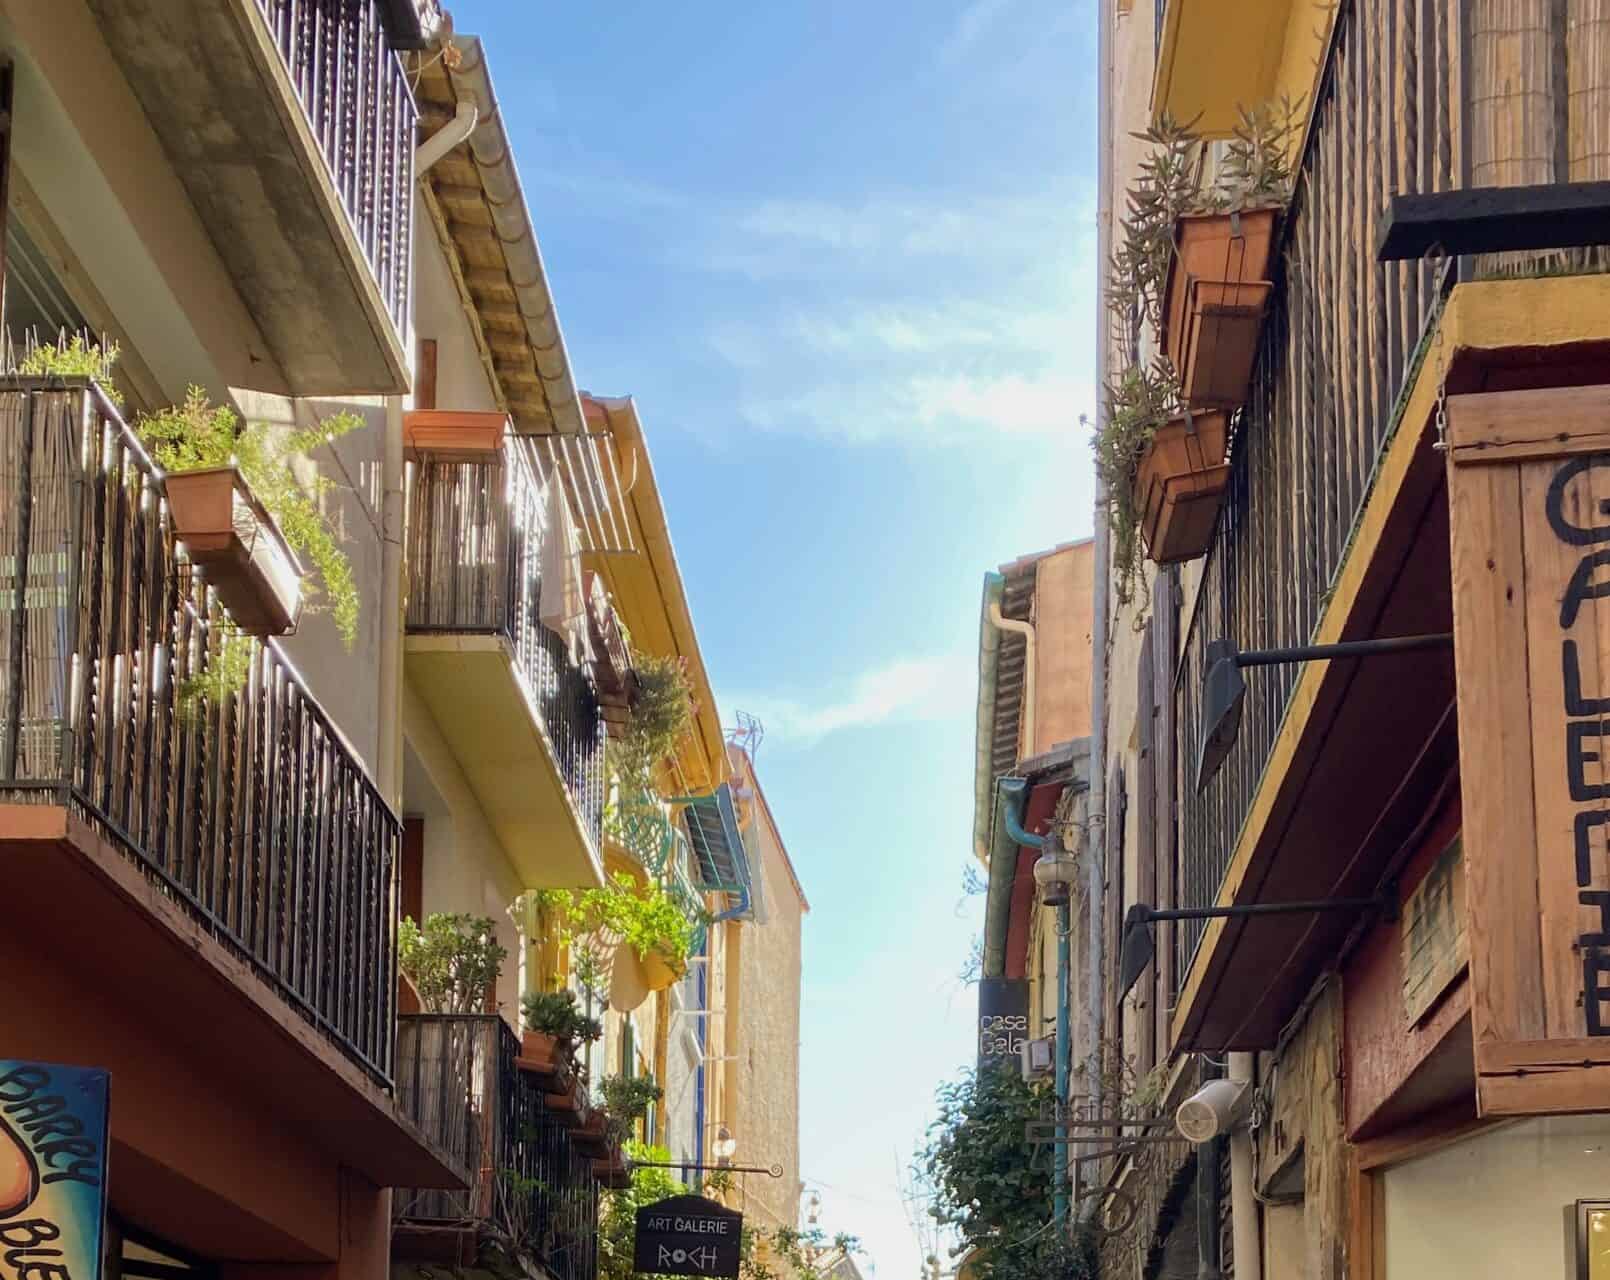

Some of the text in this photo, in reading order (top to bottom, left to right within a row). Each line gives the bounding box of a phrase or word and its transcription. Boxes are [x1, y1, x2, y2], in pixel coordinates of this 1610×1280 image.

[0, 1064, 100, 1185] BARRY
[648, 1217, 728, 1234] ART GALERIE
[658, 1245, 717, 1270] ROCH
